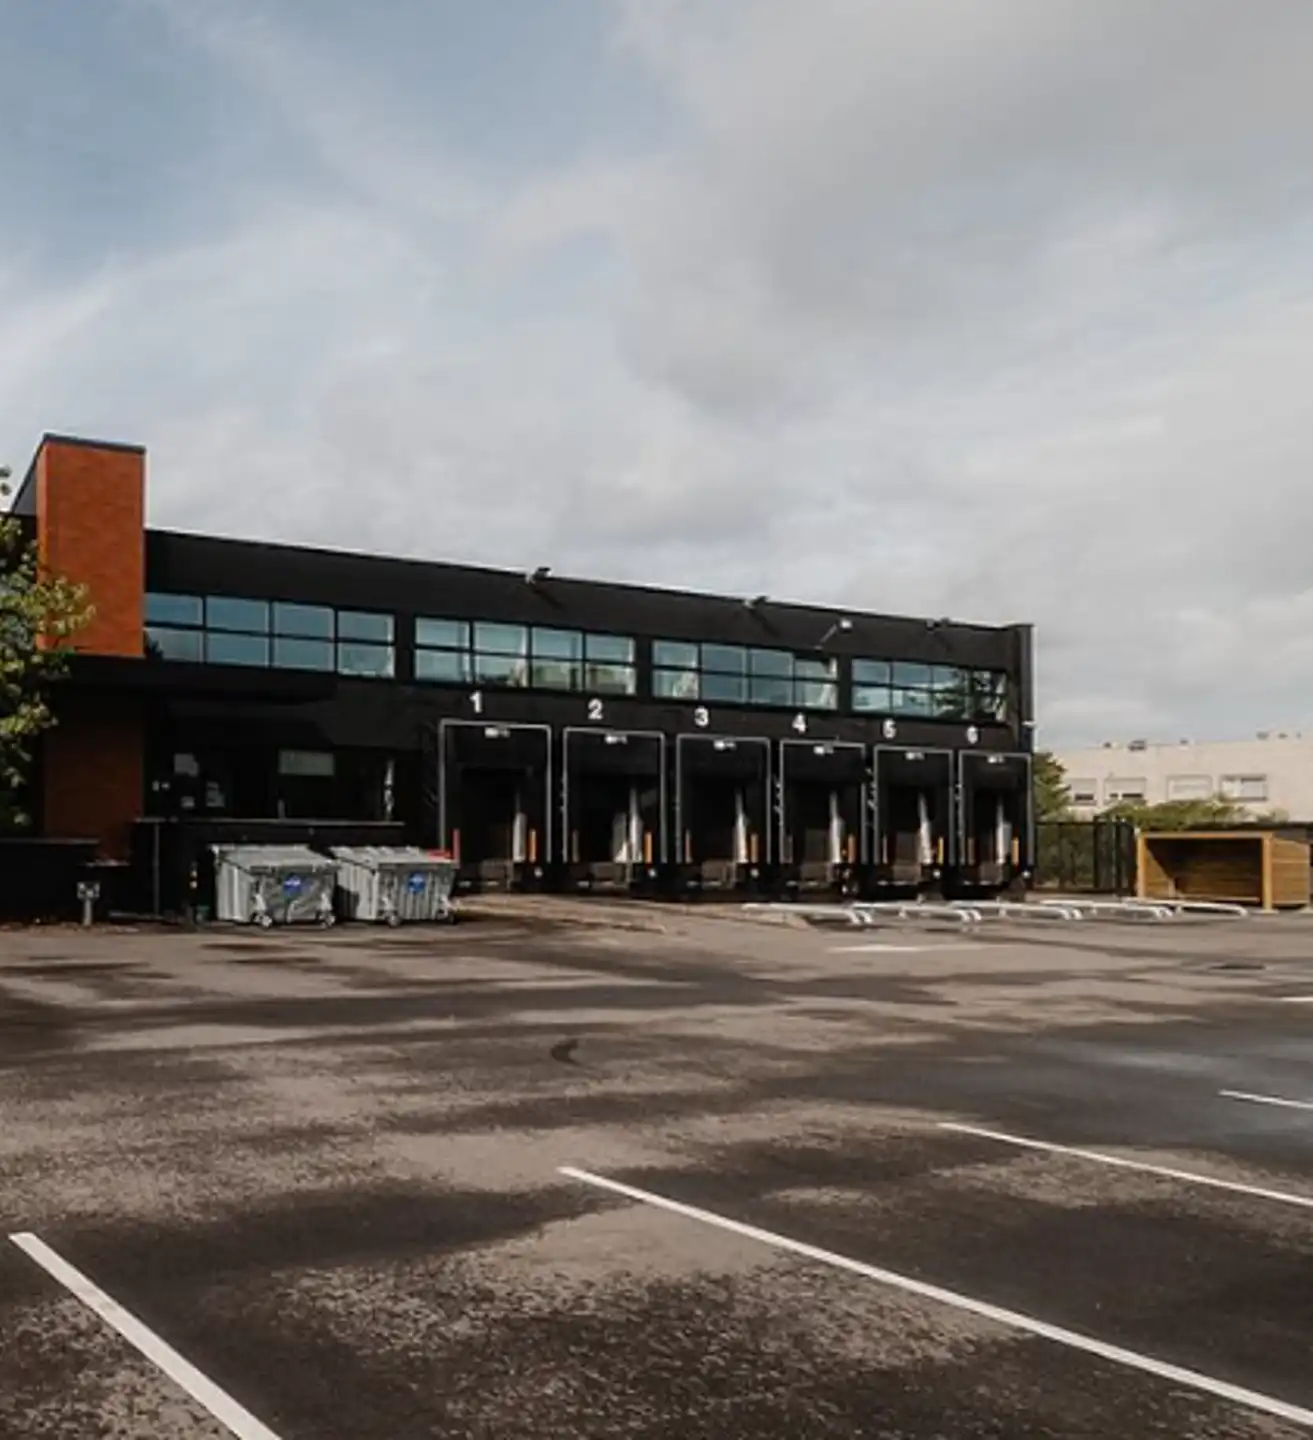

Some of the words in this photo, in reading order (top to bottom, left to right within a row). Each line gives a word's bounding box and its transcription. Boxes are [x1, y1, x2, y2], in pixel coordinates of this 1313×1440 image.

[468, 690, 481, 713] 1
[588, 698, 603, 720] 2
[695, 707, 709, 727] 3
[792, 713, 808, 733] 4
[883, 719, 896, 739] 5
[966, 726, 978, 745] 6
